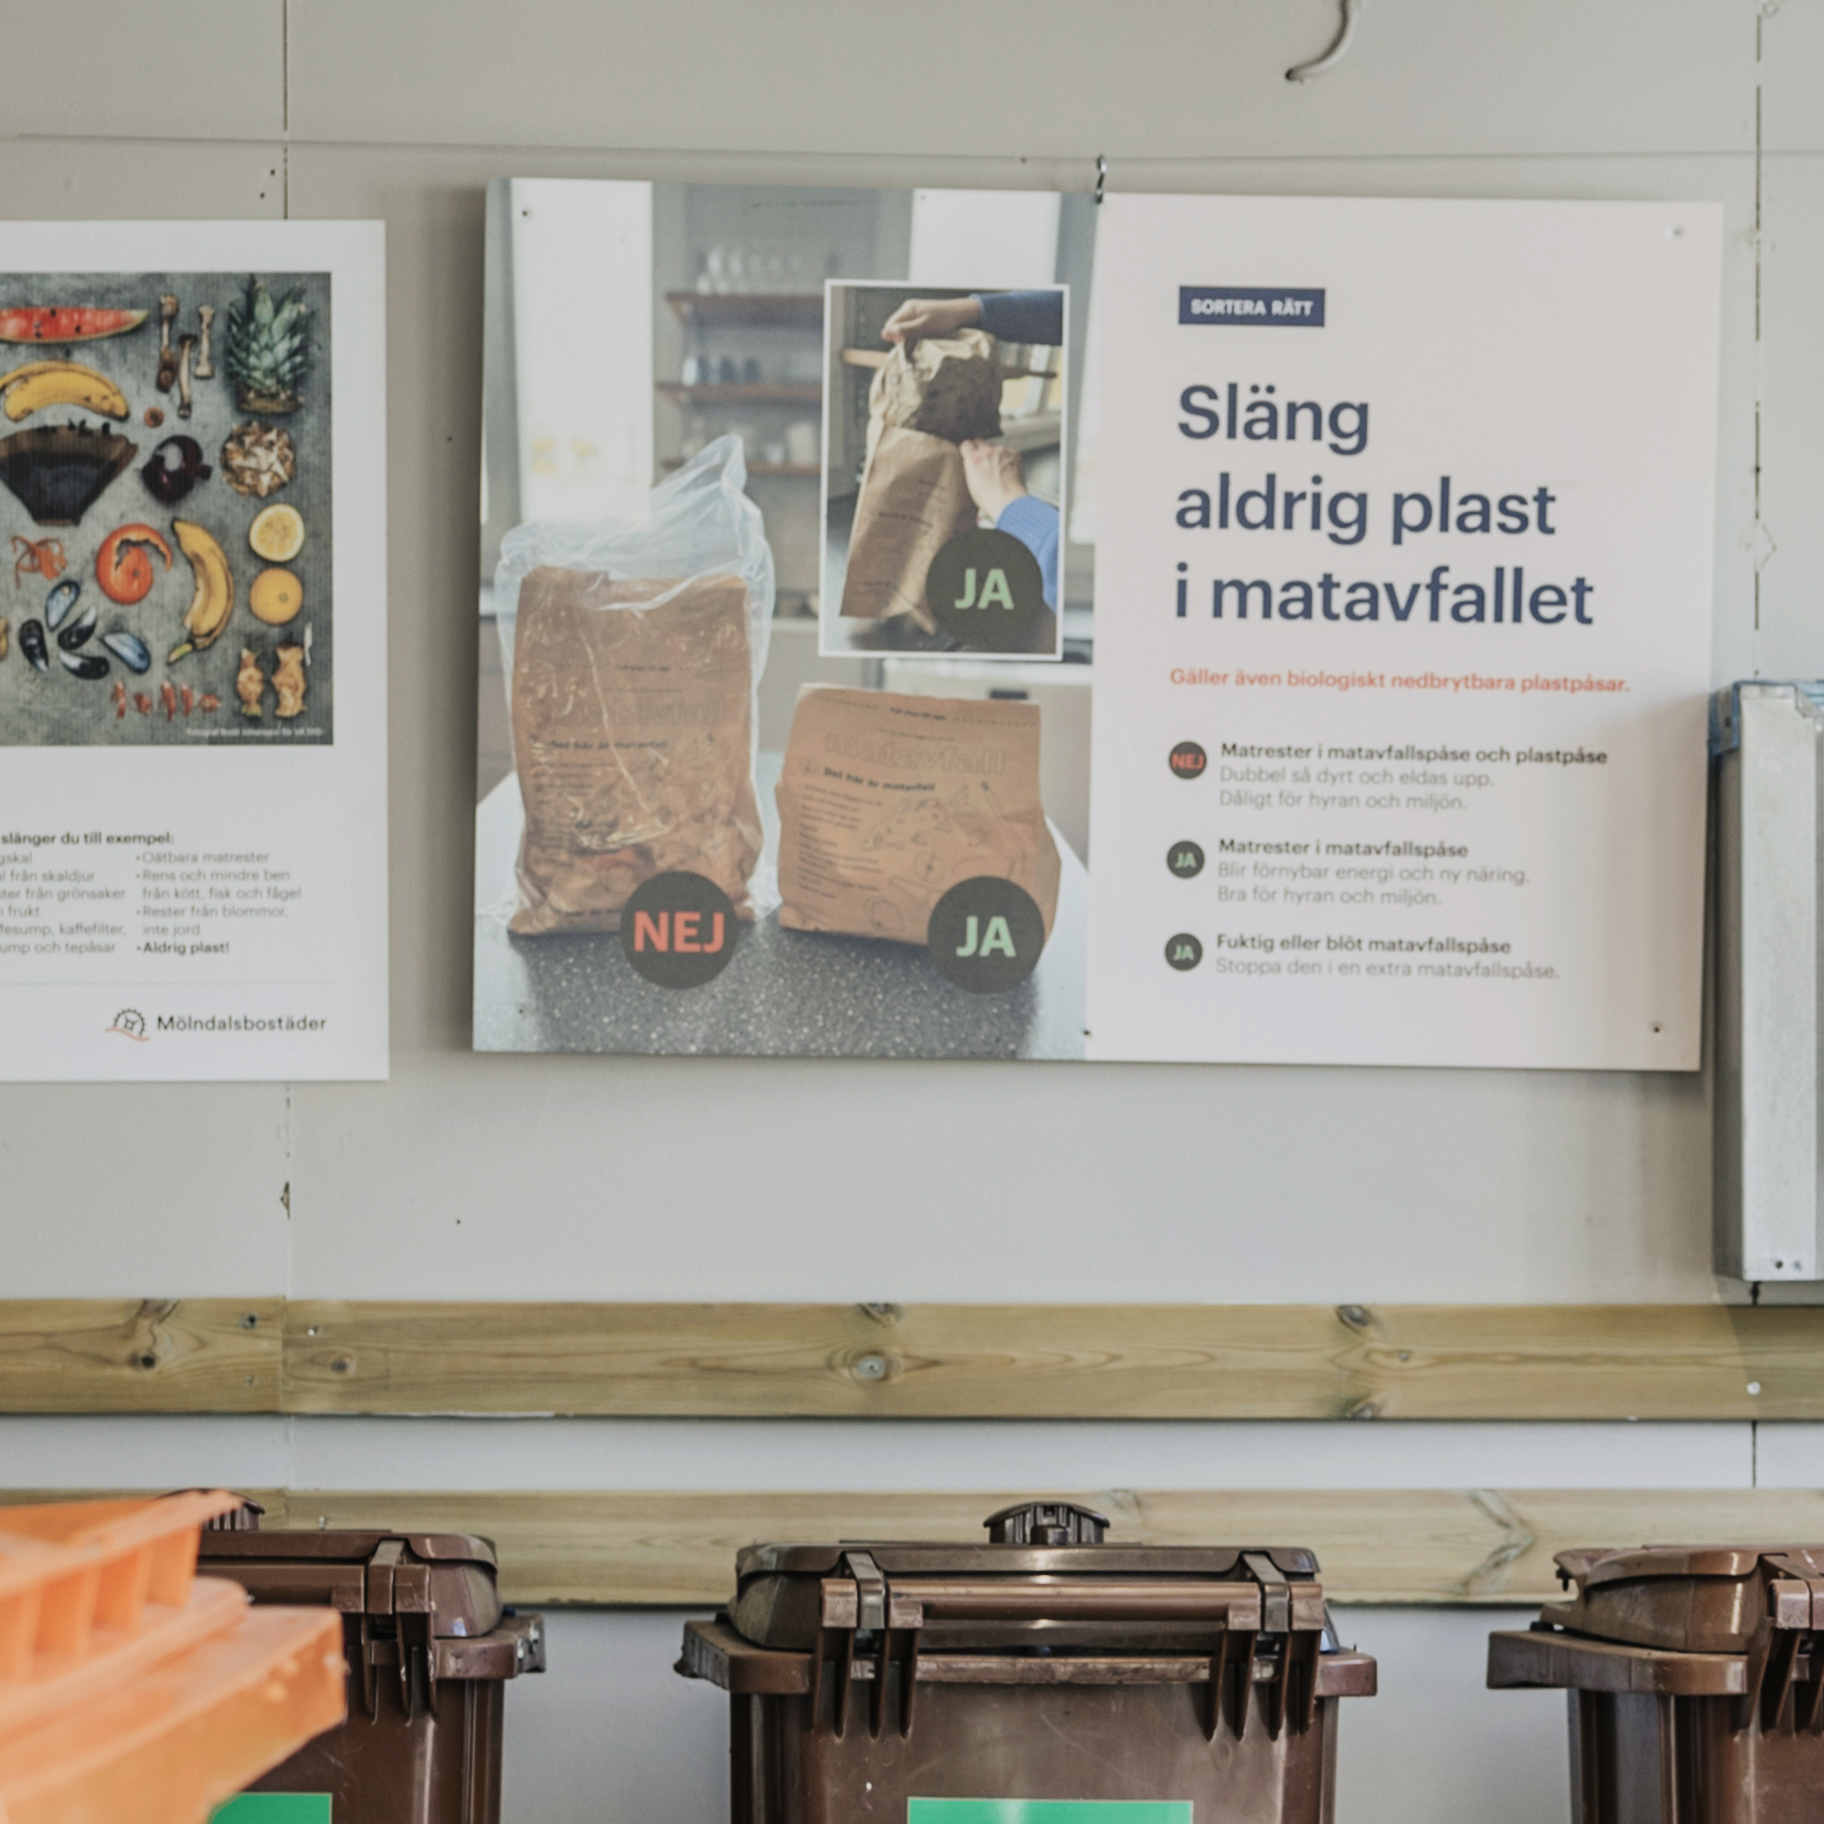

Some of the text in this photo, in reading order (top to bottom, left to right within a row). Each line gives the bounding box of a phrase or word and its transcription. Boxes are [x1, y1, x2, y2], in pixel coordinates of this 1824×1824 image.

[1190, 297, 1314, 316] SORTERA RÄTT
[1178, 382, 1368, 456] Släng
[1175, 471, 1556, 547] aldrig plast
[954, 568, 1015, 610] JA
[1176, 561, 1594, 625] i matavfallet
[1170, 667, 1630, 695] Gäller även biologiskt nedbrytbara plastpåsar.
[1171, 752, 1204, 769] NEJ
[1221, 742, 1609, 767] Matrester i matavfallspåse och plastpåse
[1220, 765, 1494, 789] Dubbel så dyrt och eldas upp.
[1219, 788, 1468, 813] Dåligt för hyran och miljön.
[1, 832, 56, 847] slänger
[60, 832, 80, 844] du
[83, 831, 102, 844] till
[105, 832, 175, 846] exempel:
[1218, 838, 1468, 860] Matrester i matavfallspåse
[142, 850, 269, 864] Oätbara matrester
[9, 868, 37, 882] från
[41, 869, 94, 884] skaldjur
[142, 868, 290, 881] Rens och mindre ben
[1218, 861, 1531, 887] Blir förnybar energi och ny näring.
[24, 886, 53, 900] från
[56, 887, 125, 902] grönsaker
[142, 886, 301, 902] från kött, fisk och fågel
[1216, 885, 1442, 908] Bra för hyran och miljön.
[7, 904, 40, 917] frukt
[142, 904, 288, 918] Rester från blommor,
[58, 922, 128, 937] kaffefilter,
[142, 923, 200, 938] inte jord
[633, 910, 725, 954] NEJ
[956, 915, 1017, 957] JA
[34, 940, 61, 953] och
[64, 940, 115, 955] tepåsar
[142, 941, 229, 956] Aldrig plast!
[1216, 933, 1511, 956] Fuktig eller blöt matavfallspåse
[1216, 957, 1561, 982] Stoppa den i en extra matavfallspåse.
[156, 1015, 326, 1031] Mölndalsbostäder
